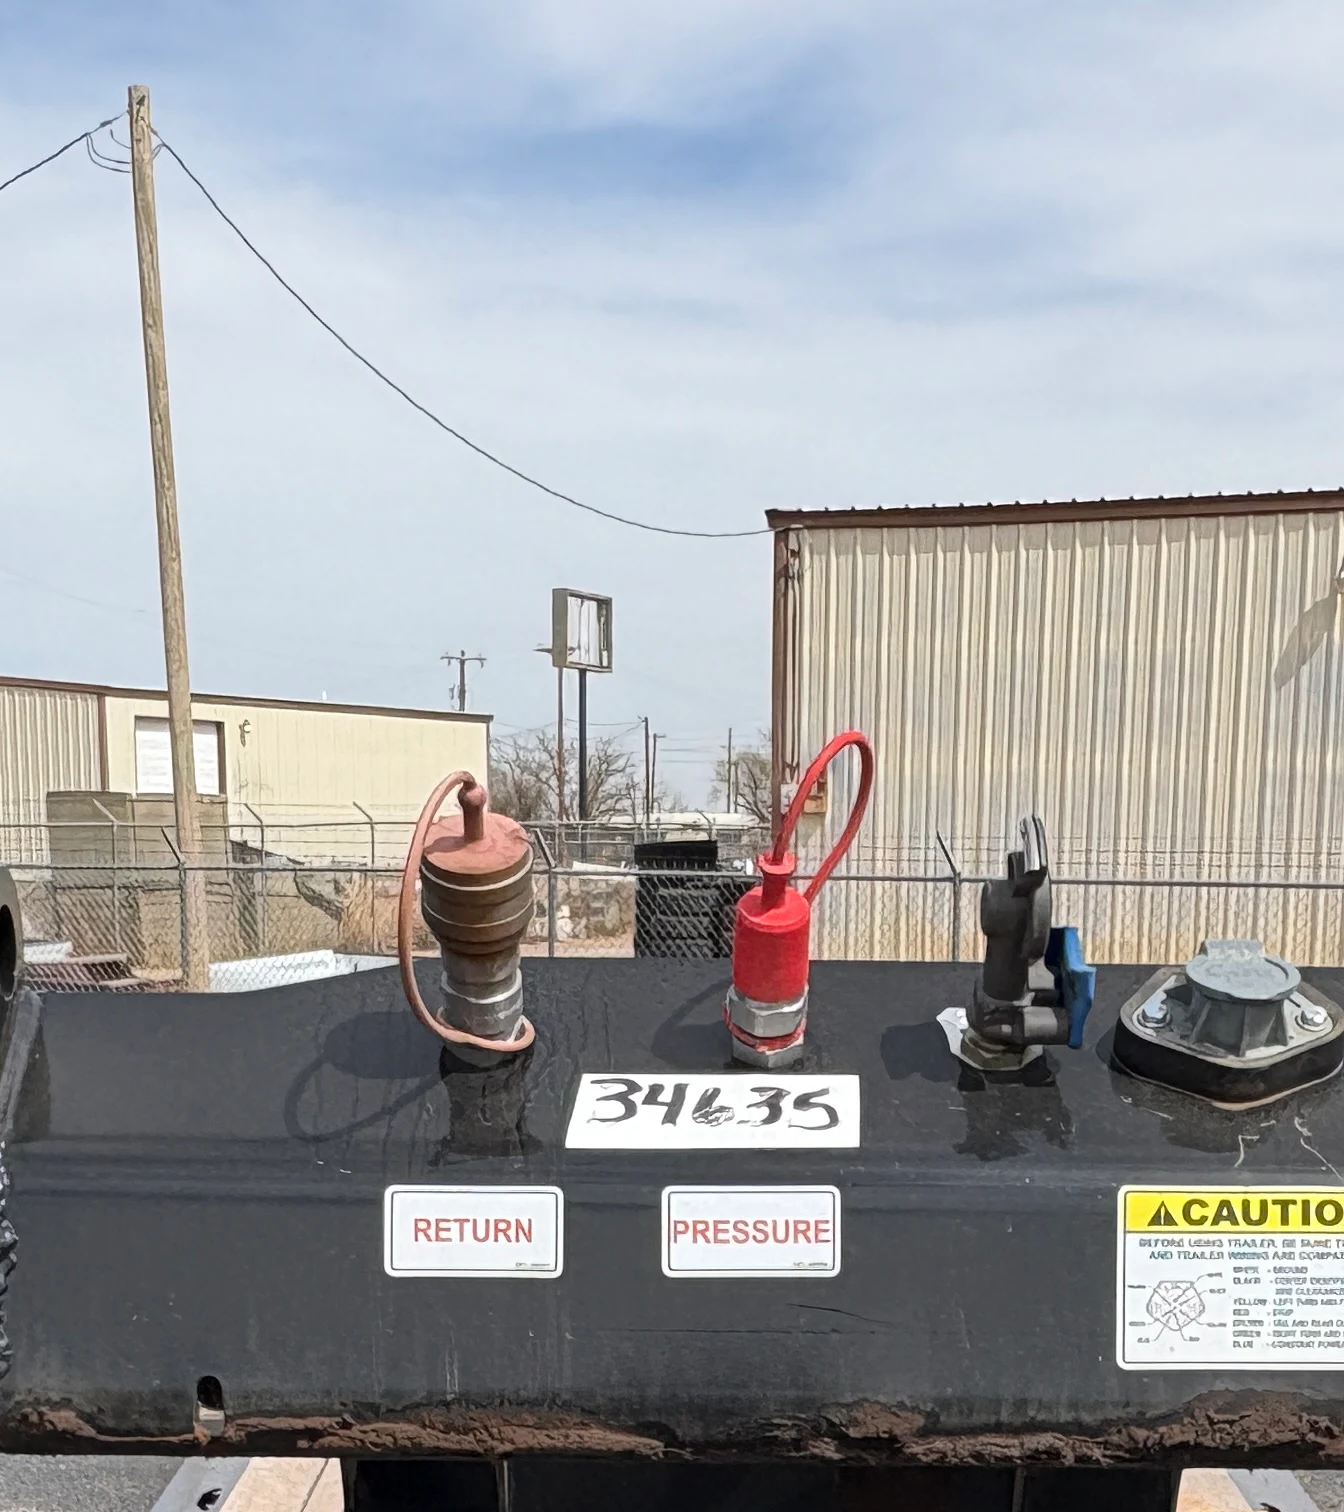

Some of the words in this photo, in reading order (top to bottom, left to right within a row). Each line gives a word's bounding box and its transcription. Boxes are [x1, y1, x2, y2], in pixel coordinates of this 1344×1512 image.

[587, 1077, 840, 1131] 34635
[413, 1218, 533, 1243] RETURN
[672, 1219, 832, 1244] PRESSURE
